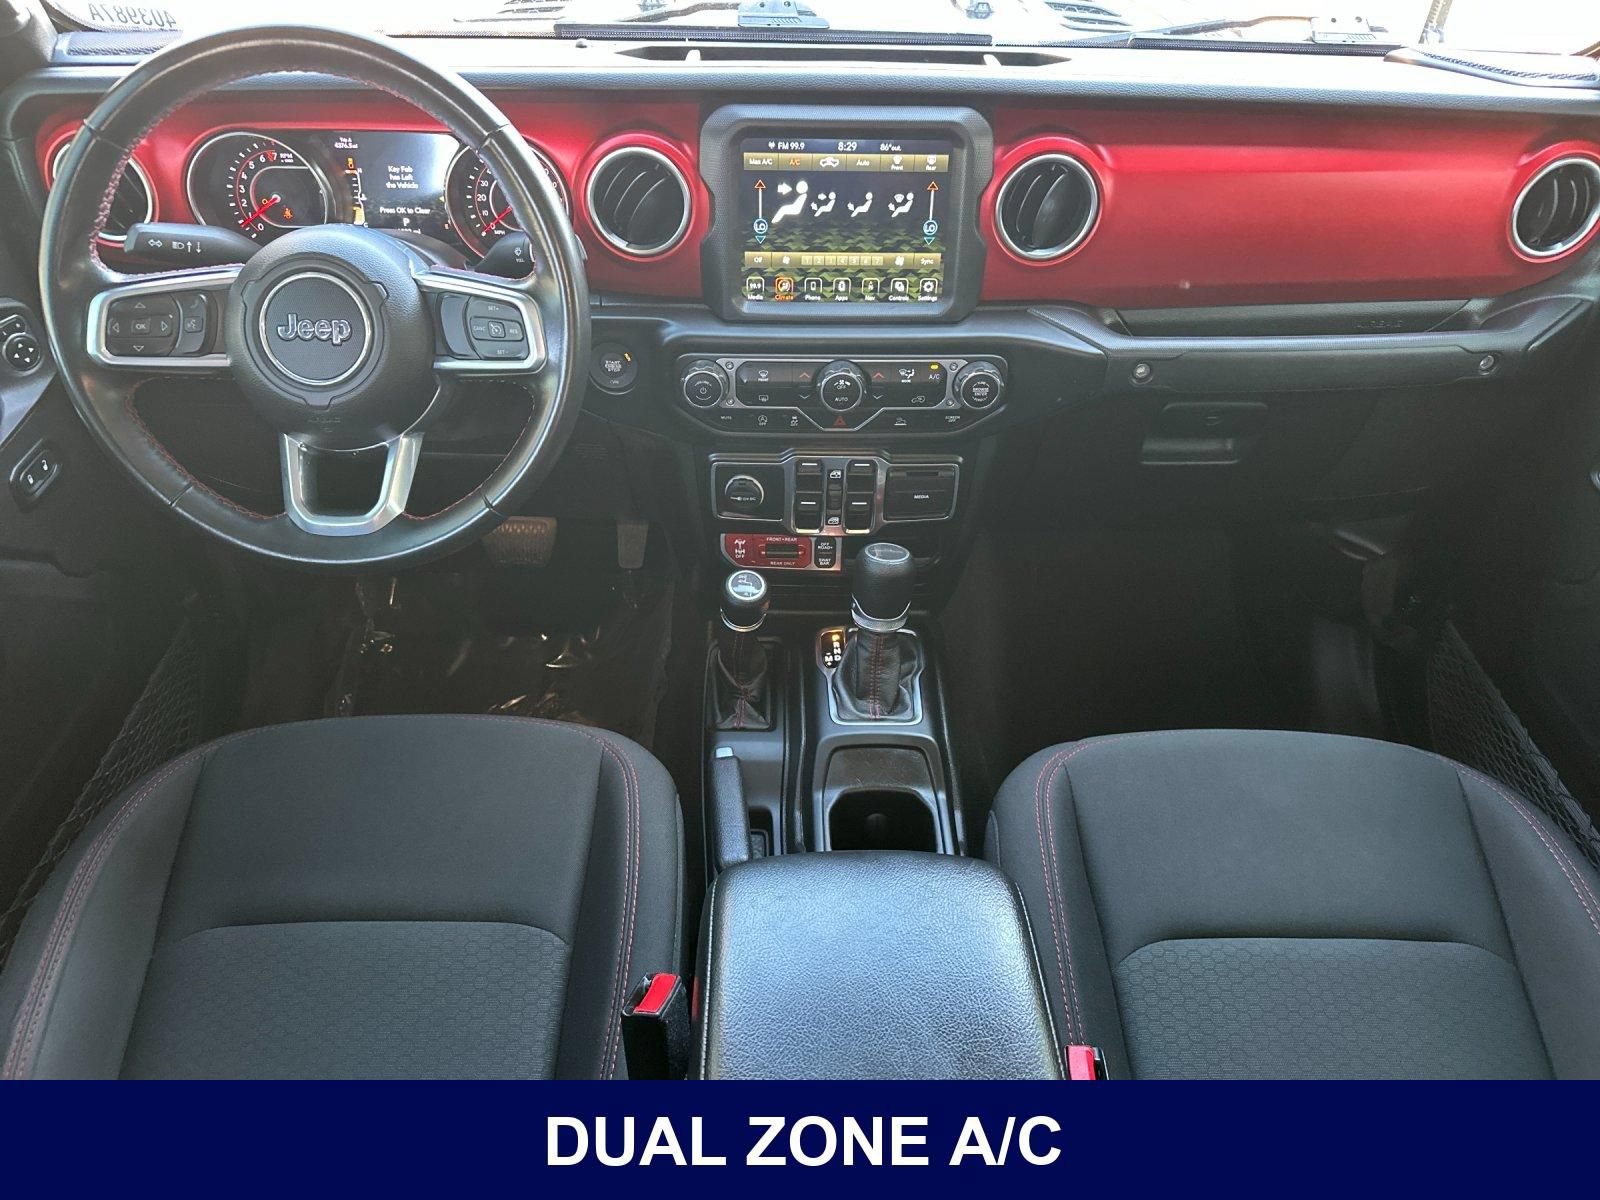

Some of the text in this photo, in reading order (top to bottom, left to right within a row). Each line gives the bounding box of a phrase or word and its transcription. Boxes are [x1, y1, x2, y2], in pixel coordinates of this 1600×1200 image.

[778, 142, 805, 150] FM 99.9
[838, 142, 857, 151] 8:29
[260, 154, 265, 163] 6
[272, 152, 277, 160] 7
[249, 161, 255, 169] 5
[241, 171, 247, 180] 4
[239, 185, 245, 193] 3
[477, 194, 487, 202] 20
[241, 199, 247, 207] 2
[379, 206, 396, 214] Press
[396, 206, 406, 214] OK
[407, 206, 414, 214] to
[403, 217, 410, 226] P
[257, 223, 264, 231] 0
[490, 222, 496, 230] 0
[754, 221, 766, 232] LO
[923, 223, 936, 234] LO
[277, 313, 351, 345] Jeep
